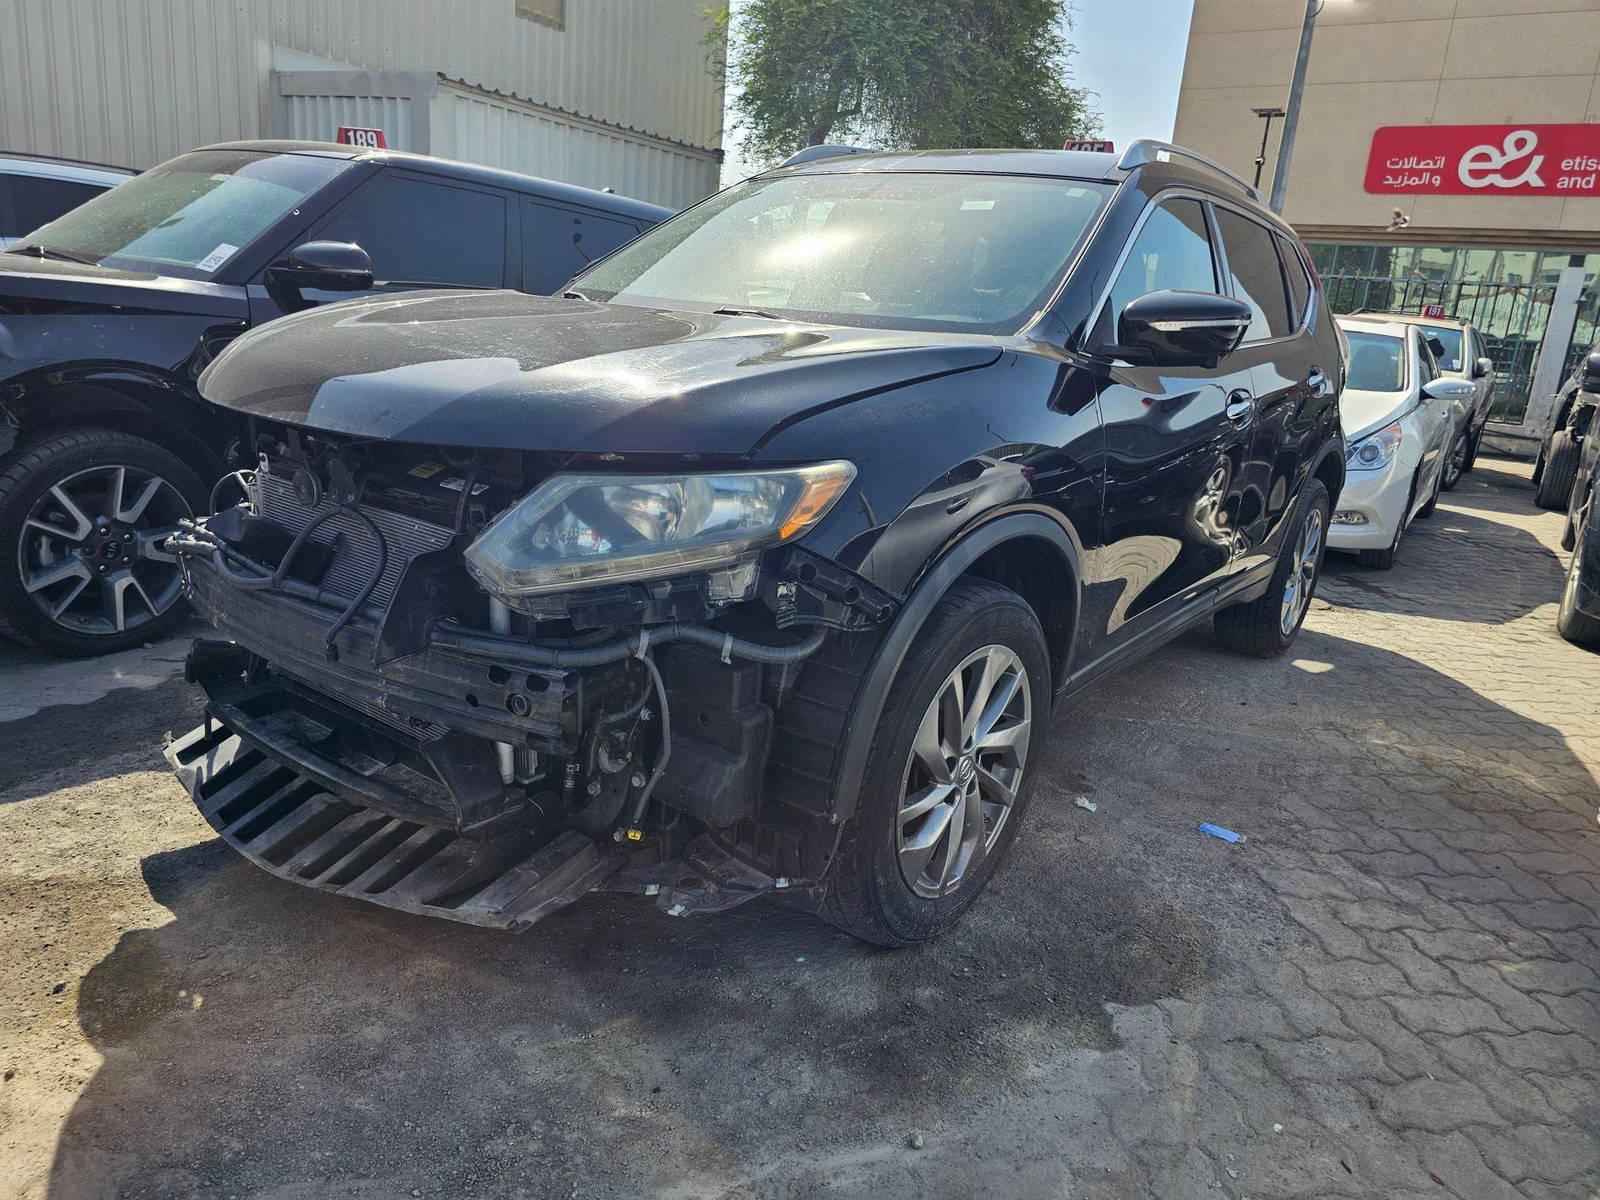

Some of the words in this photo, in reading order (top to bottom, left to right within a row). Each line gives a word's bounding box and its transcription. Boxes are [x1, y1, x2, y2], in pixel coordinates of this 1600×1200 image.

[347, 130, 377, 147] 189
[1386, 156, 1446, 169] اتصالات
[1458, 129, 1546, 188] e&
[1561, 155, 1600, 170] etis
[1556, 173, 1596, 189] and
